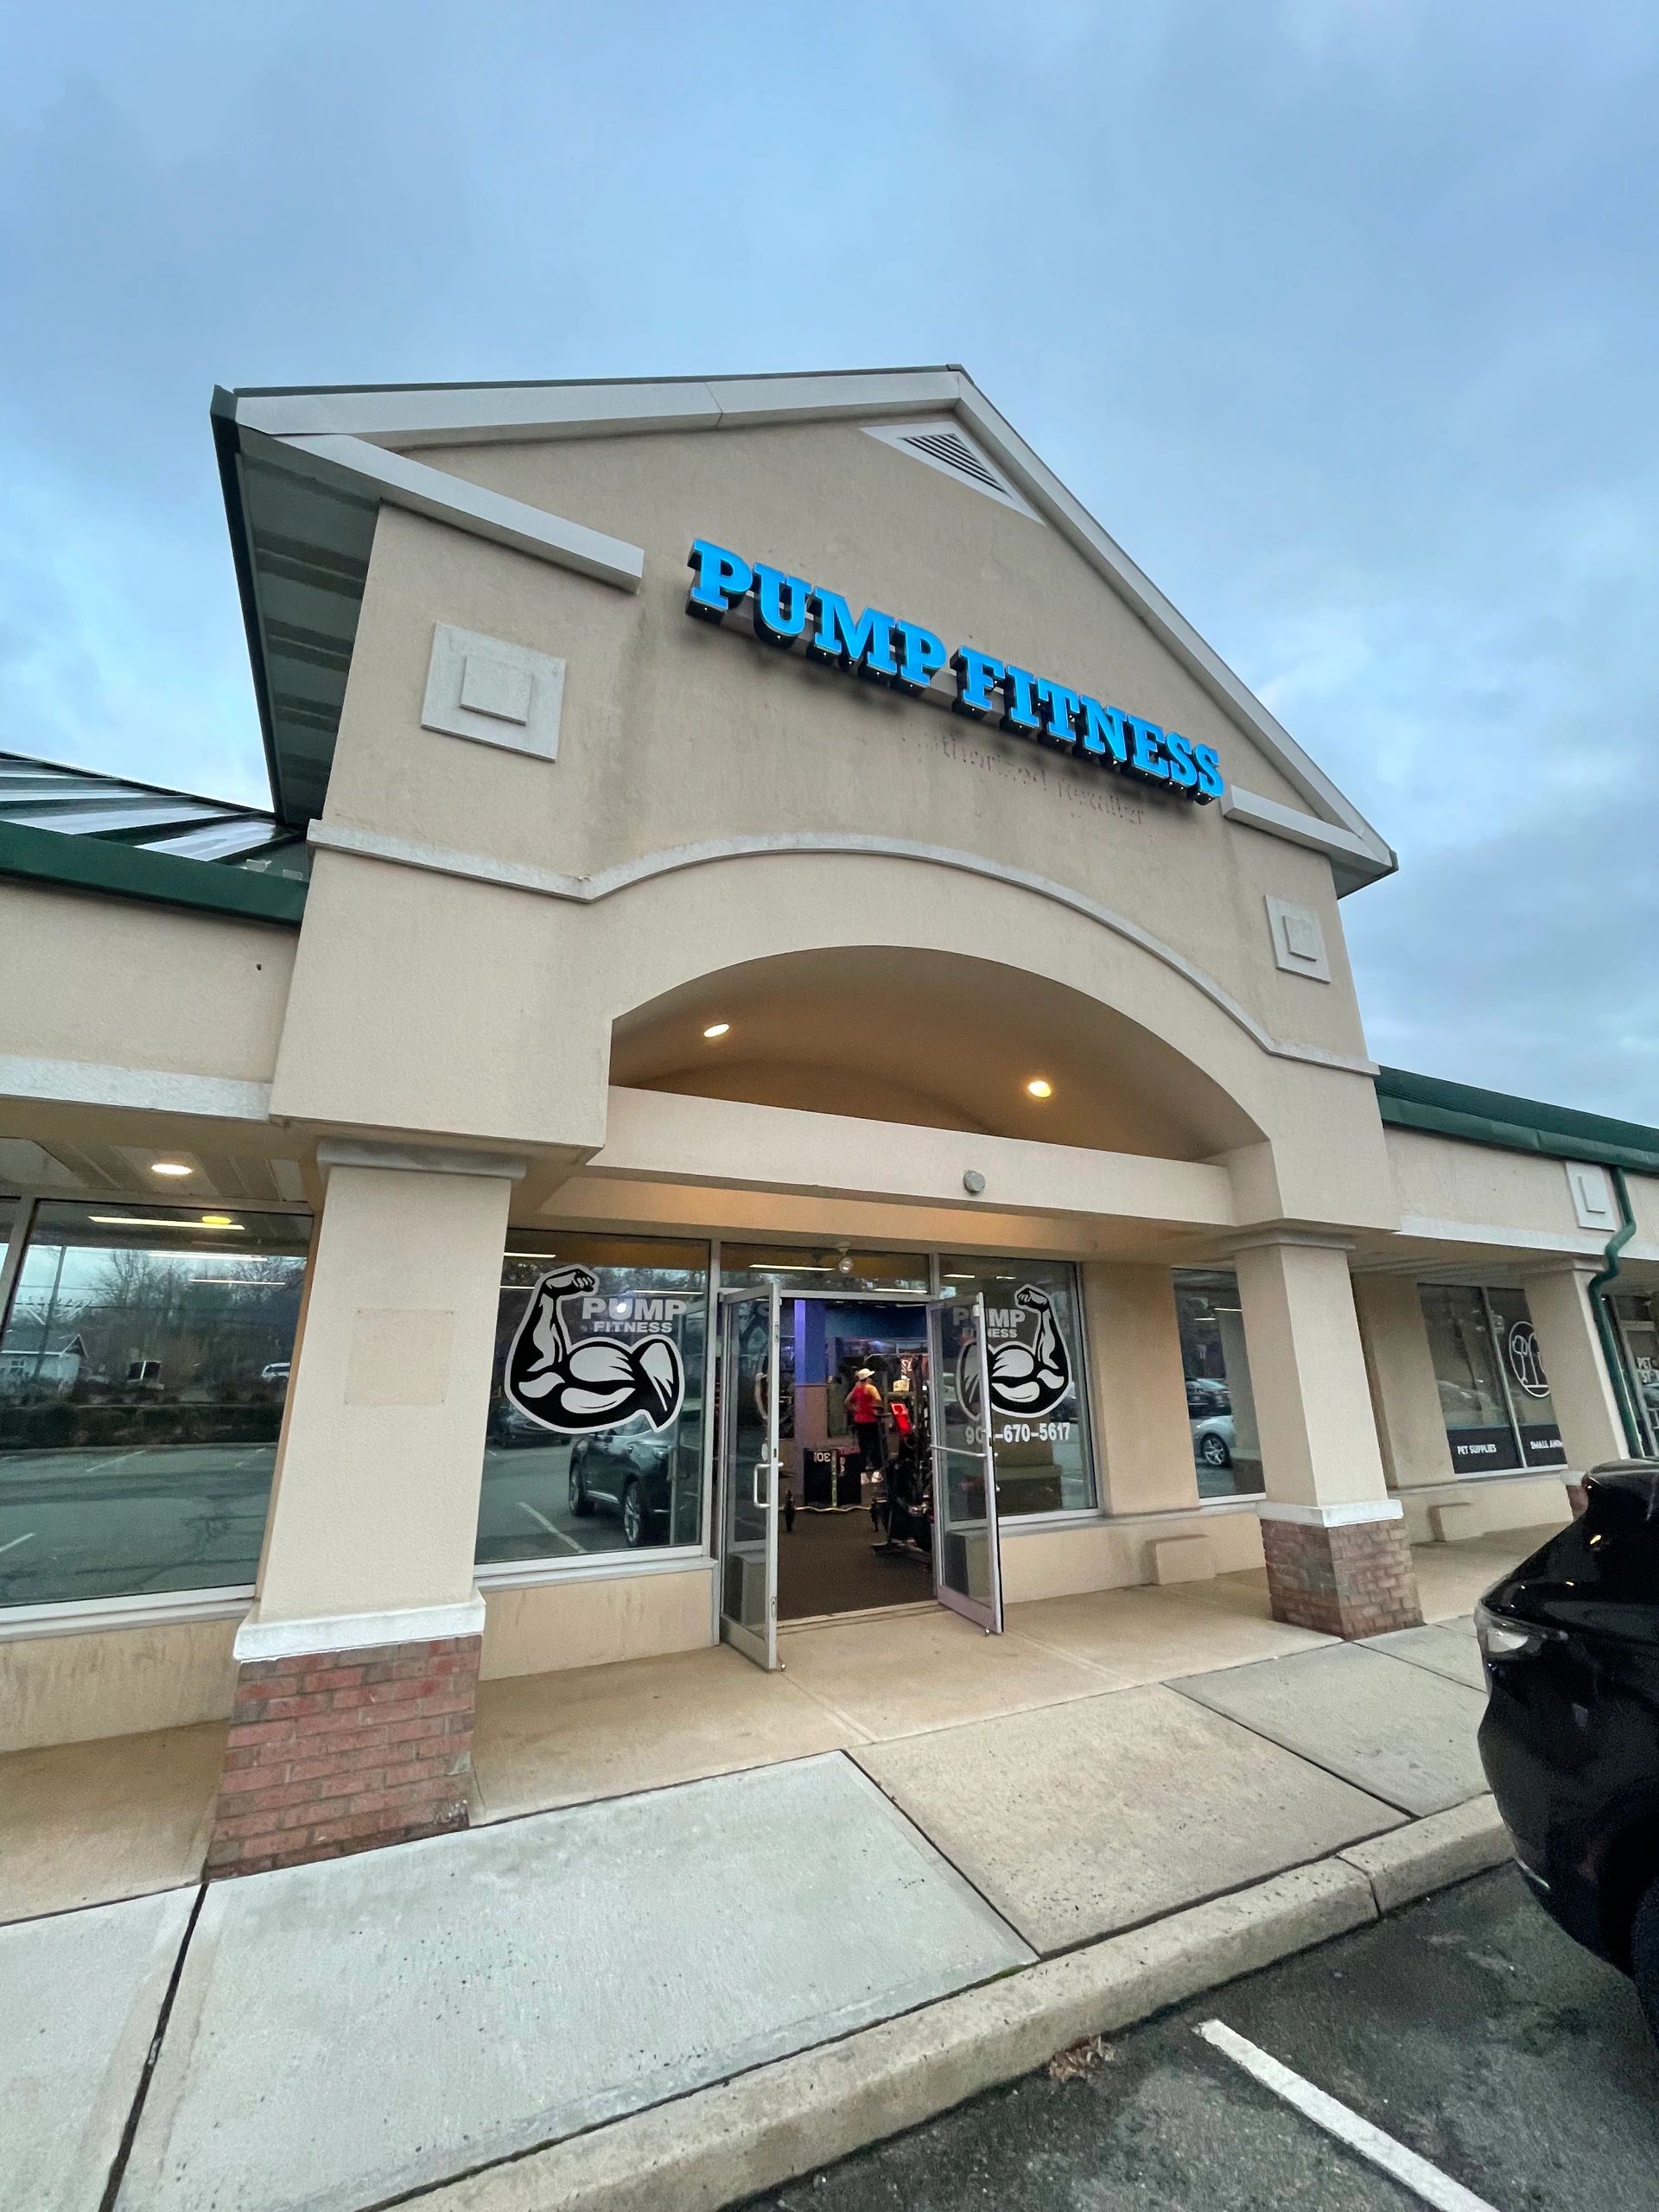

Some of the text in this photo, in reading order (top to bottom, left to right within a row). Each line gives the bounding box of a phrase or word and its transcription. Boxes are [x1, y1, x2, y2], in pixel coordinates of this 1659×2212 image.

[690, 539, 946, 689] PUMP
[954, 645, 1224, 801] FITNESS
[582, 1297, 687, 1320] PUMP
[953, 1306, 1026, 1327] PMP
[594, 1321, 672, 1333] FITNESS
[962, 1326, 1018, 1338] FIESS
[965, 1422, 1071, 1445] 90-670-5617
[1457, 1444, 1497, 1455] PET SUPPLIES
